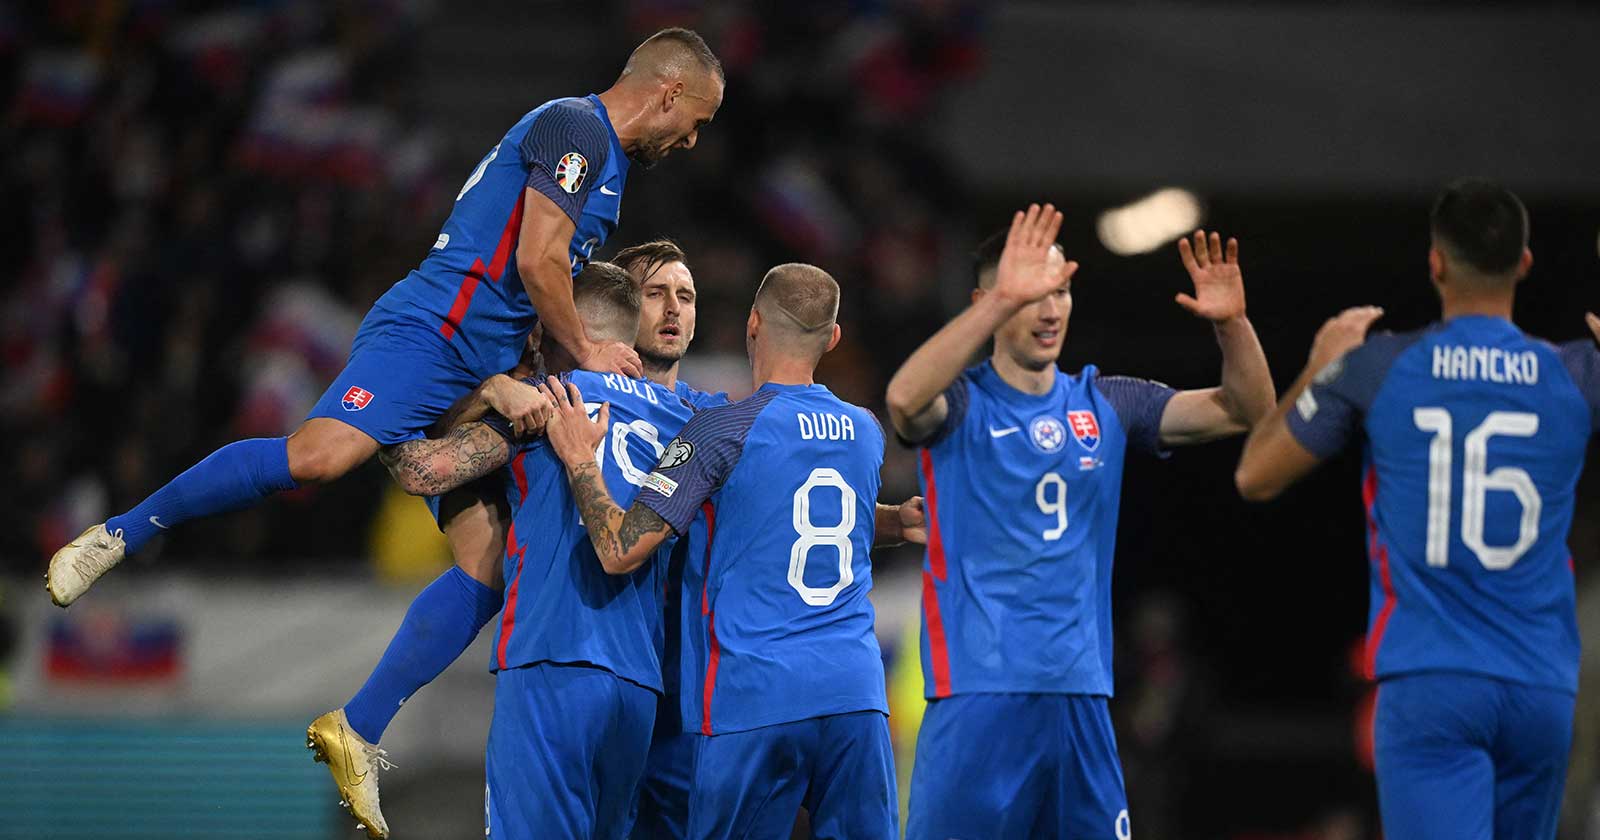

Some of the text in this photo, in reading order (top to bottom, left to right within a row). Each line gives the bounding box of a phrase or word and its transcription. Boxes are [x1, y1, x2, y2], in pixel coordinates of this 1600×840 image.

[1432, 345, 1539, 385] HANCKO
[797, 412, 855, 441] DUDA
[1036, 474, 1069, 541] 9
[1413, 406, 1542, 571] 16
[787, 467, 856, 606] 8
